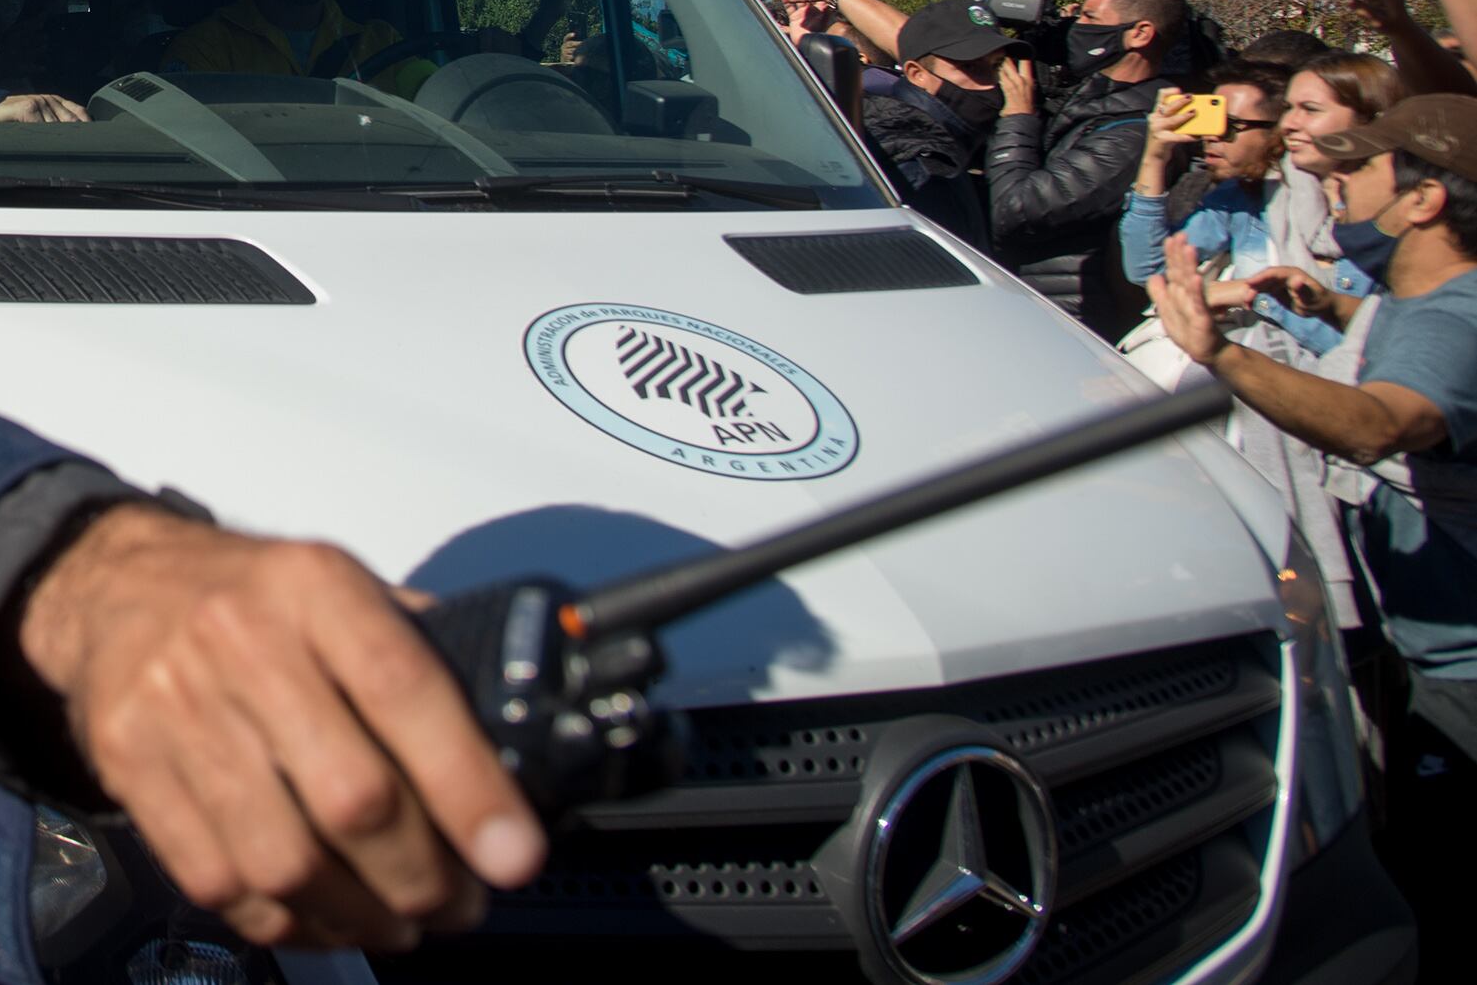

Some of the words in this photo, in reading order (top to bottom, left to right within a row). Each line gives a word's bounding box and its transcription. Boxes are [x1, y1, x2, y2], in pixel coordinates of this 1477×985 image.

[536, 313, 580, 387] ADMINISTRACION
[599, 308, 681, 324] PARQUES
[686, 321, 798, 375] NACIONALES
[711, 421, 792, 446] APN
[671, 437, 847, 473] ARGENTINA
